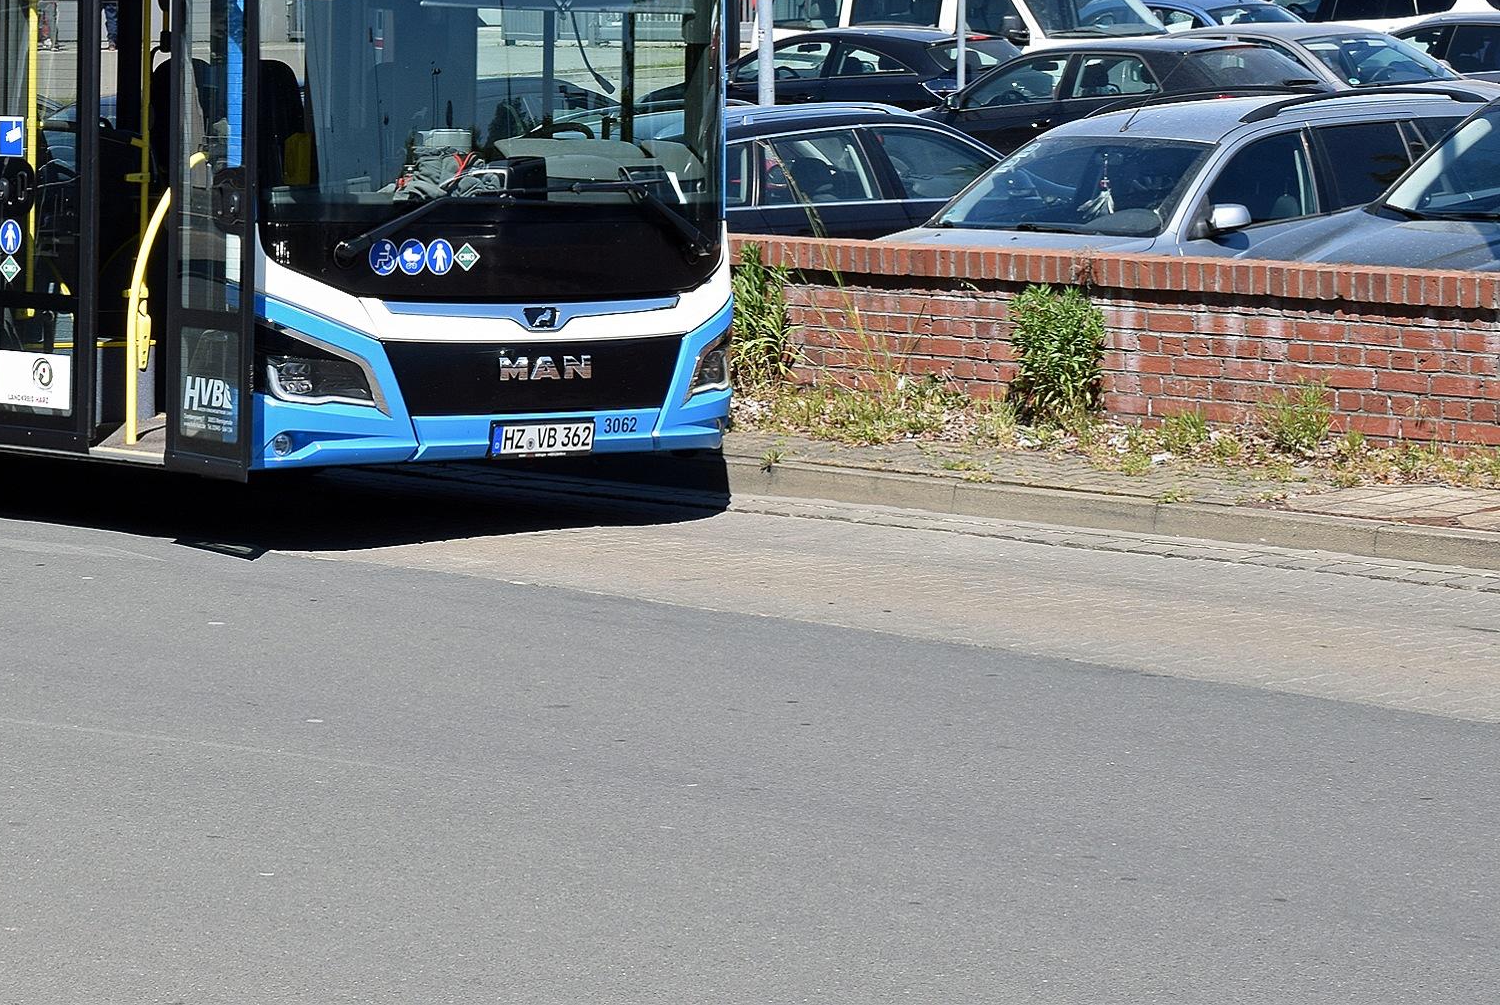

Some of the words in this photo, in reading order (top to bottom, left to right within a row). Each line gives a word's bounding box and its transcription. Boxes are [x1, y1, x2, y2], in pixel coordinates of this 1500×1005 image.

[458, 252, 475, 262] CNG
[500, 355, 593, 381] MAN
[183, 375, 225, 411] HVB
[503, 428, 526, 451] HZ
[537, 426, 558, 449] VB
[561, 425, 592, 447] 362
[604, 416, 638, 434] 3062
